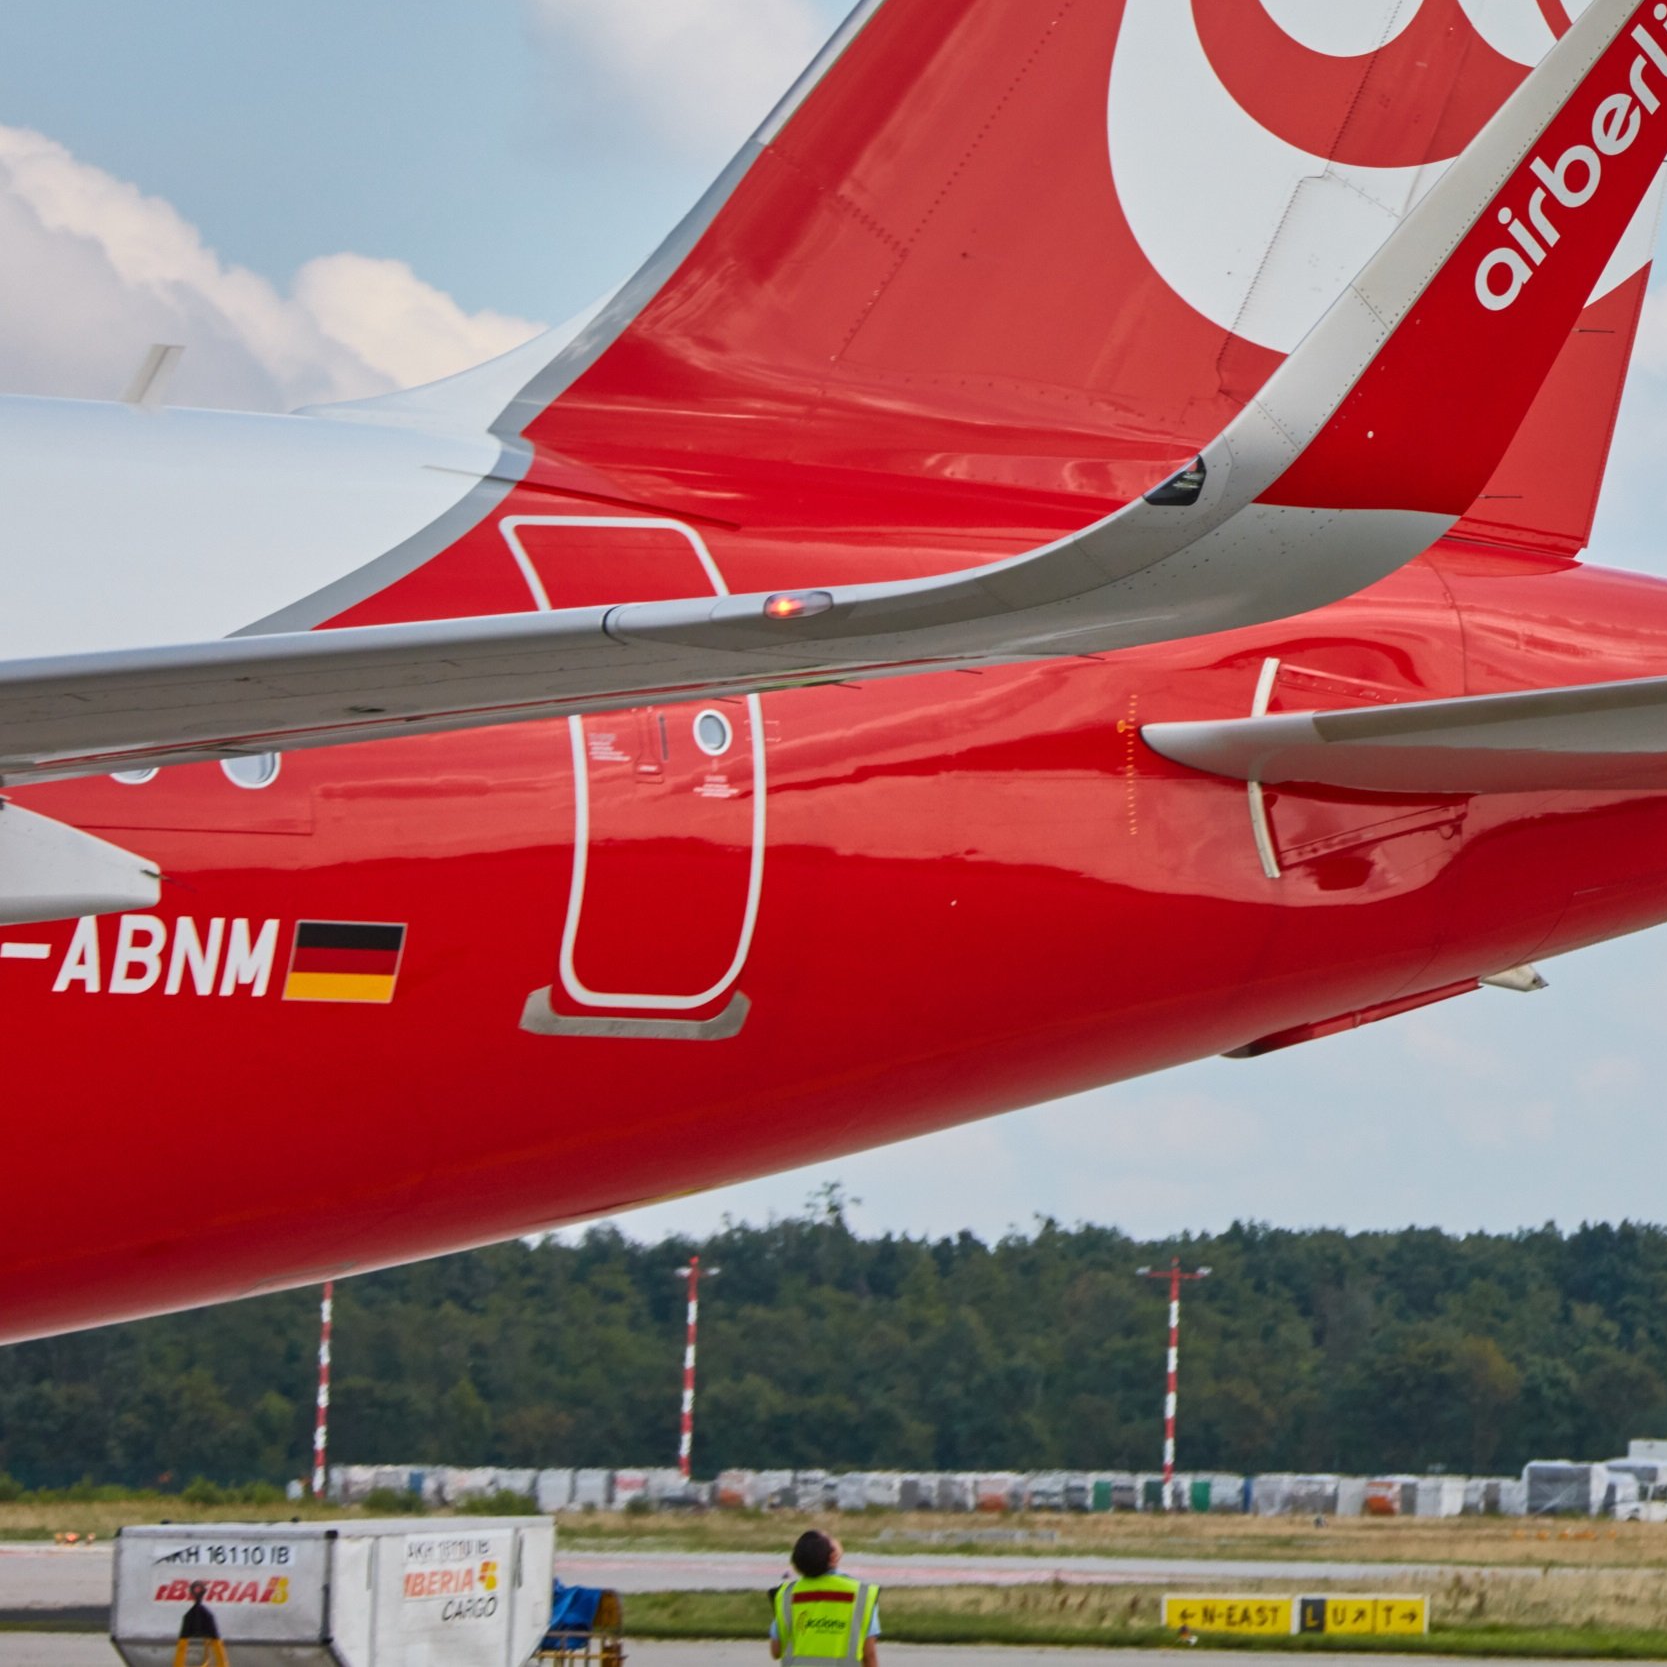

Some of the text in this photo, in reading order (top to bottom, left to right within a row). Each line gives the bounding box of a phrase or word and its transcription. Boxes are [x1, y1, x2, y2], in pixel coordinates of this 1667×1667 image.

[206, 1545, 265, 1564] 16110
[270, 1545, 290, 1564] IB
[403, 1568, 474, 1598] IBERIA
[441, 1597, 497, 1622] CARGO
[1202, 1605, 1281, 1628] N-EAST
[1305, 1605, 1319, 1627] L
[1332, 1607, 1346, 1627] U
[1383, 1605, 1395, 1627] T
